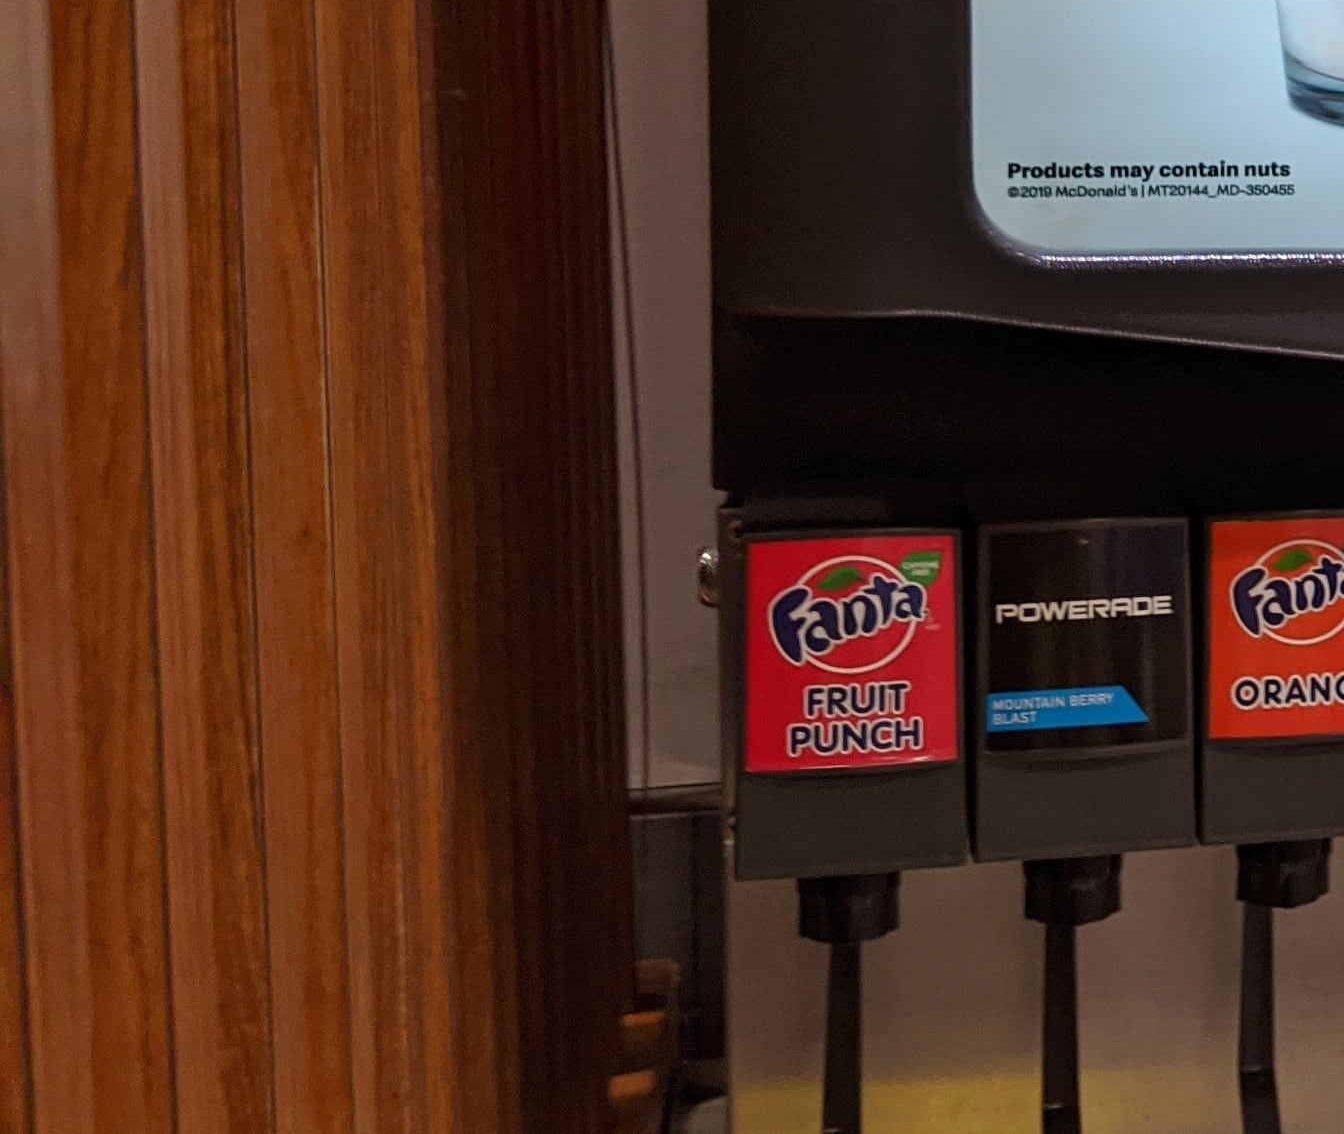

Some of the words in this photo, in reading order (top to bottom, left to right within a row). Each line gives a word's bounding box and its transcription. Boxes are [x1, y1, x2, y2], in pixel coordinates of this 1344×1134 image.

[1007, 162, 1105, 180] Products
[1110, 165, 1154, 183] may
[1159, 160, 1239, 178] contain
[1244, 162, 1291, 178] nuts
[1007, 186, 1051, 199] ©2019
[768, 573, 928, 667] Fanta
[996, 595, 1173, 624] POWERADE
[804, 681, 911, 719] FRUIT
[992, 696, 1066, 711] MOUNTAIN
[1069, 692, 1115, 708] BERRY
[992, 710, 1038, 726] BLAST
[786, 717, 925, 757] PUNCH
